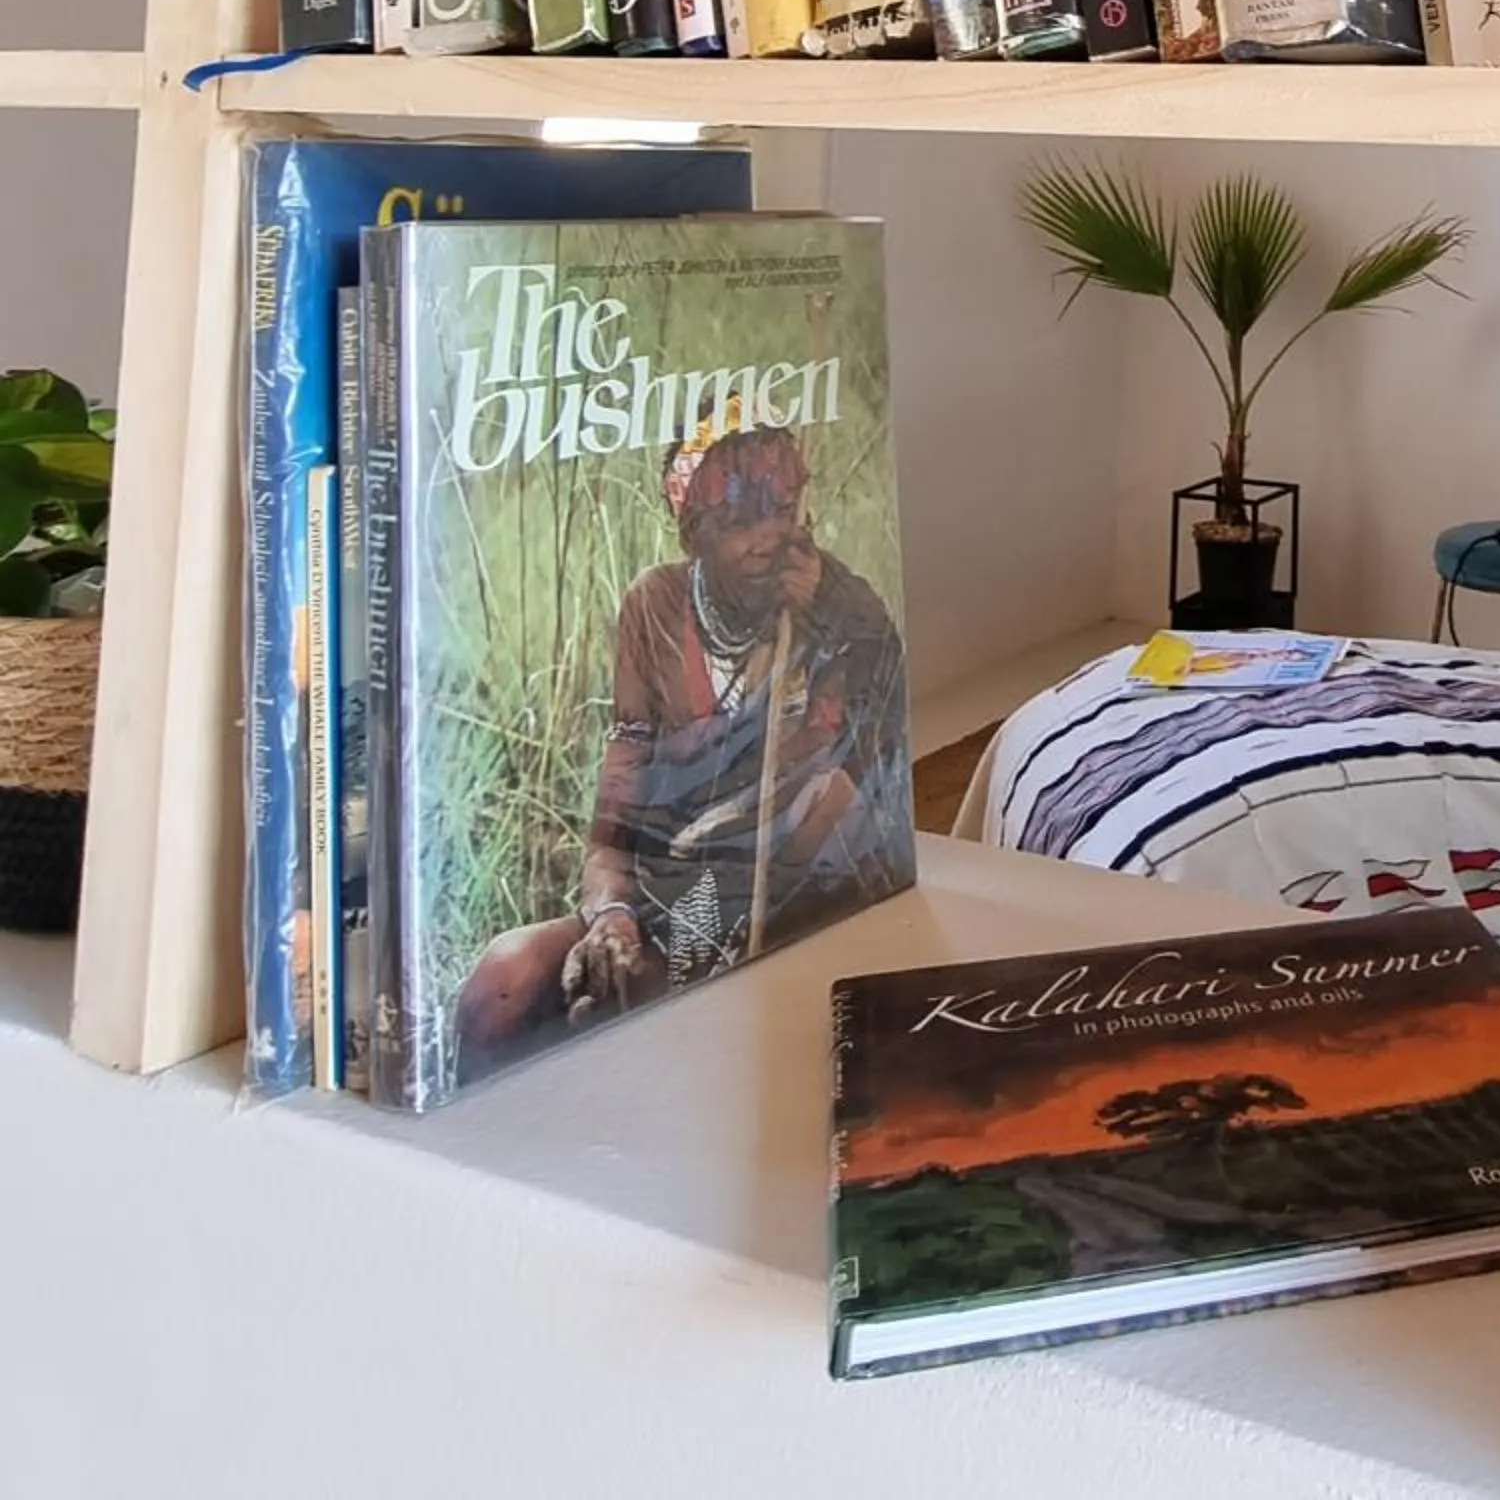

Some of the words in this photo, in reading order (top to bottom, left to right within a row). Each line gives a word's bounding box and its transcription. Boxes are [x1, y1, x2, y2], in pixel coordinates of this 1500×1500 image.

[467, 263, 631, 385] The
[451, 355, 844, 472] bushmen
[367, 440, 398, 503] The
[368, 514, 398, 691] bushmen
[312, 651, 326, 683] THE
[312, 684, 327, 742] WHALE
[313, 747, 328, 804] FAMILY
[314, 807, 329, 855] BOOK
[908, 950, 1233, 1035] Kalahari
[1253, 940, 1484, 992] Summer
[1073, 1020, 1098, 1037] in
[1106, 1001, 1264, 1038] photographs
[1269, 989, 1315, 1013] and
[1321, 984, 1365, 1006] oils
